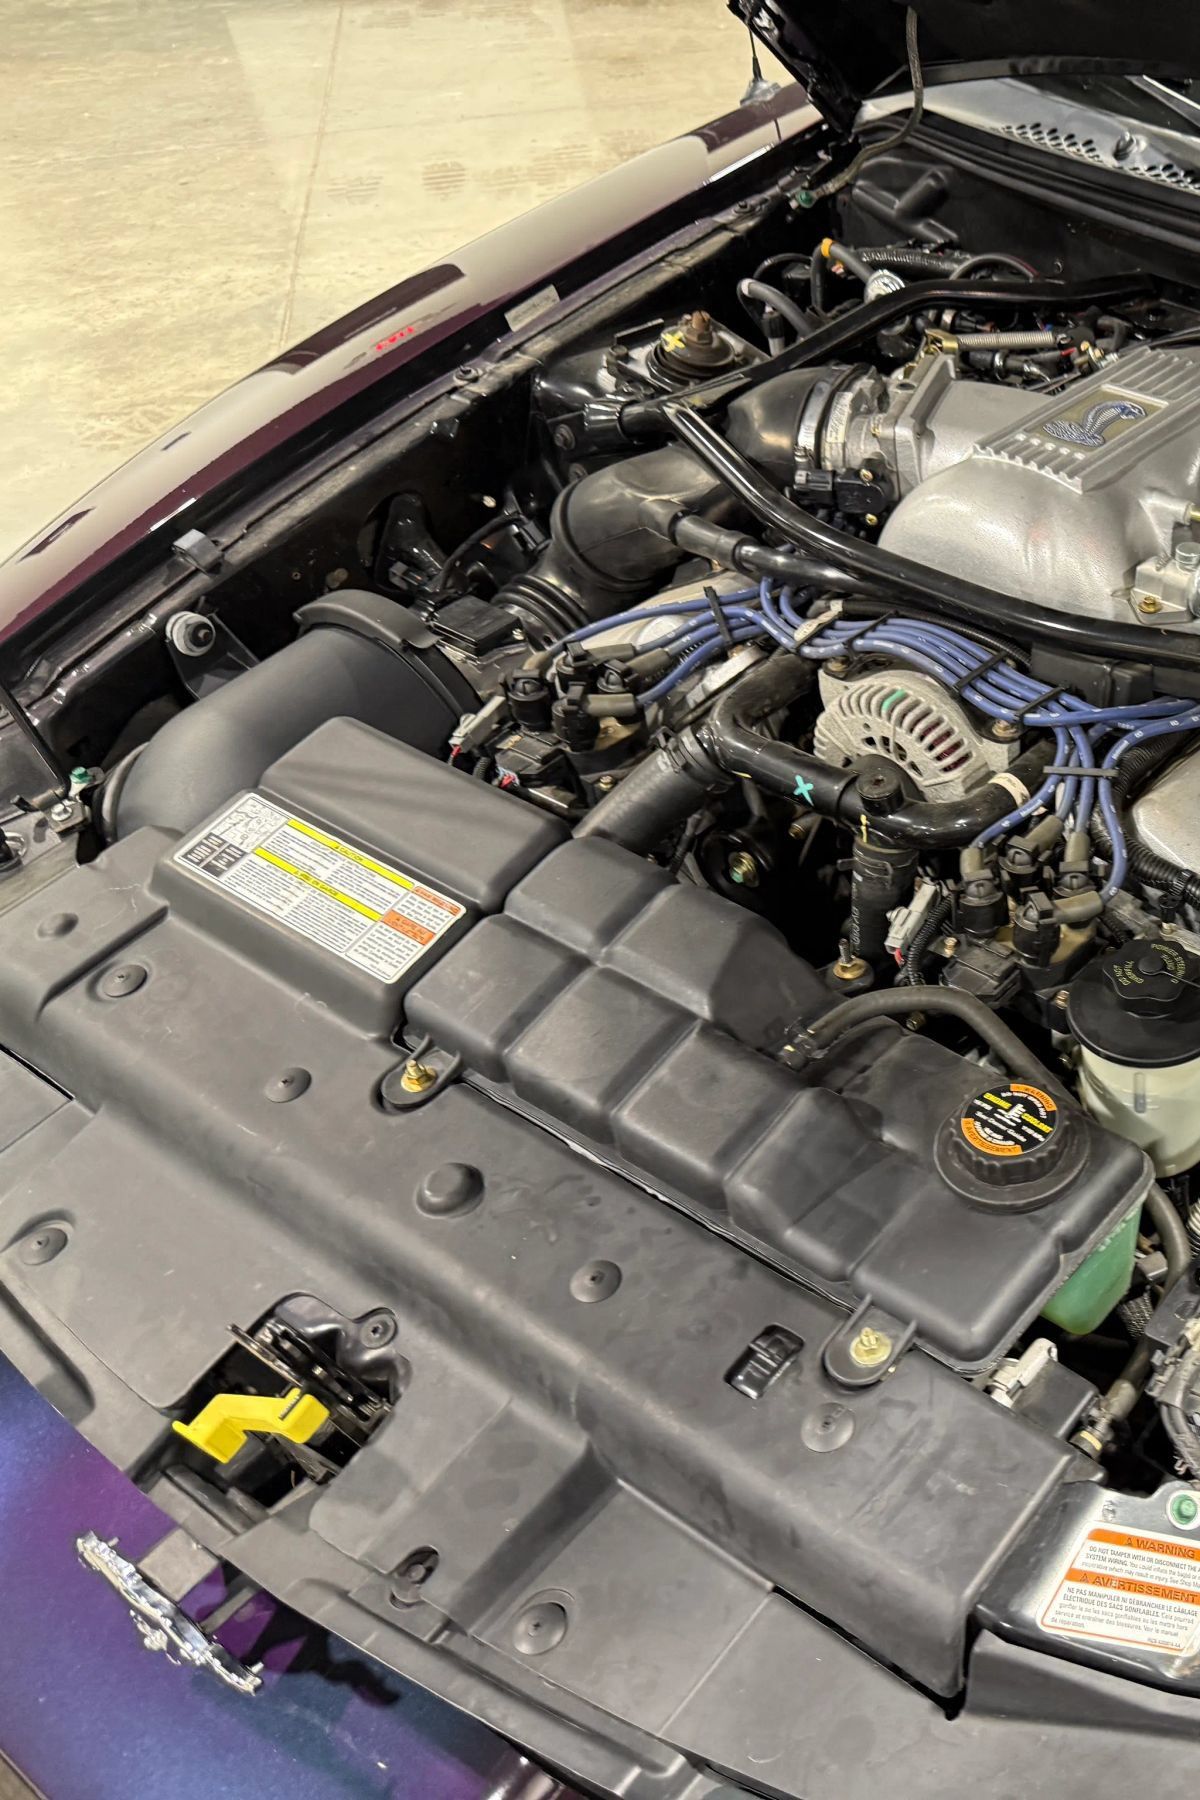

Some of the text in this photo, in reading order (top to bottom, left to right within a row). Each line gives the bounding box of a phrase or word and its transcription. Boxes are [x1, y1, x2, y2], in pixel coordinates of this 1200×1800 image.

[1151, 944, 1178, 956] POWER
[1136, 1538, 1195, 1559] WARNING
[1086, 1553, 1106, 1562] SYSTEM
[1110, 1550, 1131, 1558] TAMPER
[1132, 1553, 1146, 1562] WITH
[1154, 1558, 1186, 1570] DISCONNECT
[1092, 1576, 1198, 1602] AVERTISSEMENT
[1088, 1590, 1120, 1601] MANIPULER
[1108, 1602, 1123, 1611] SACS
